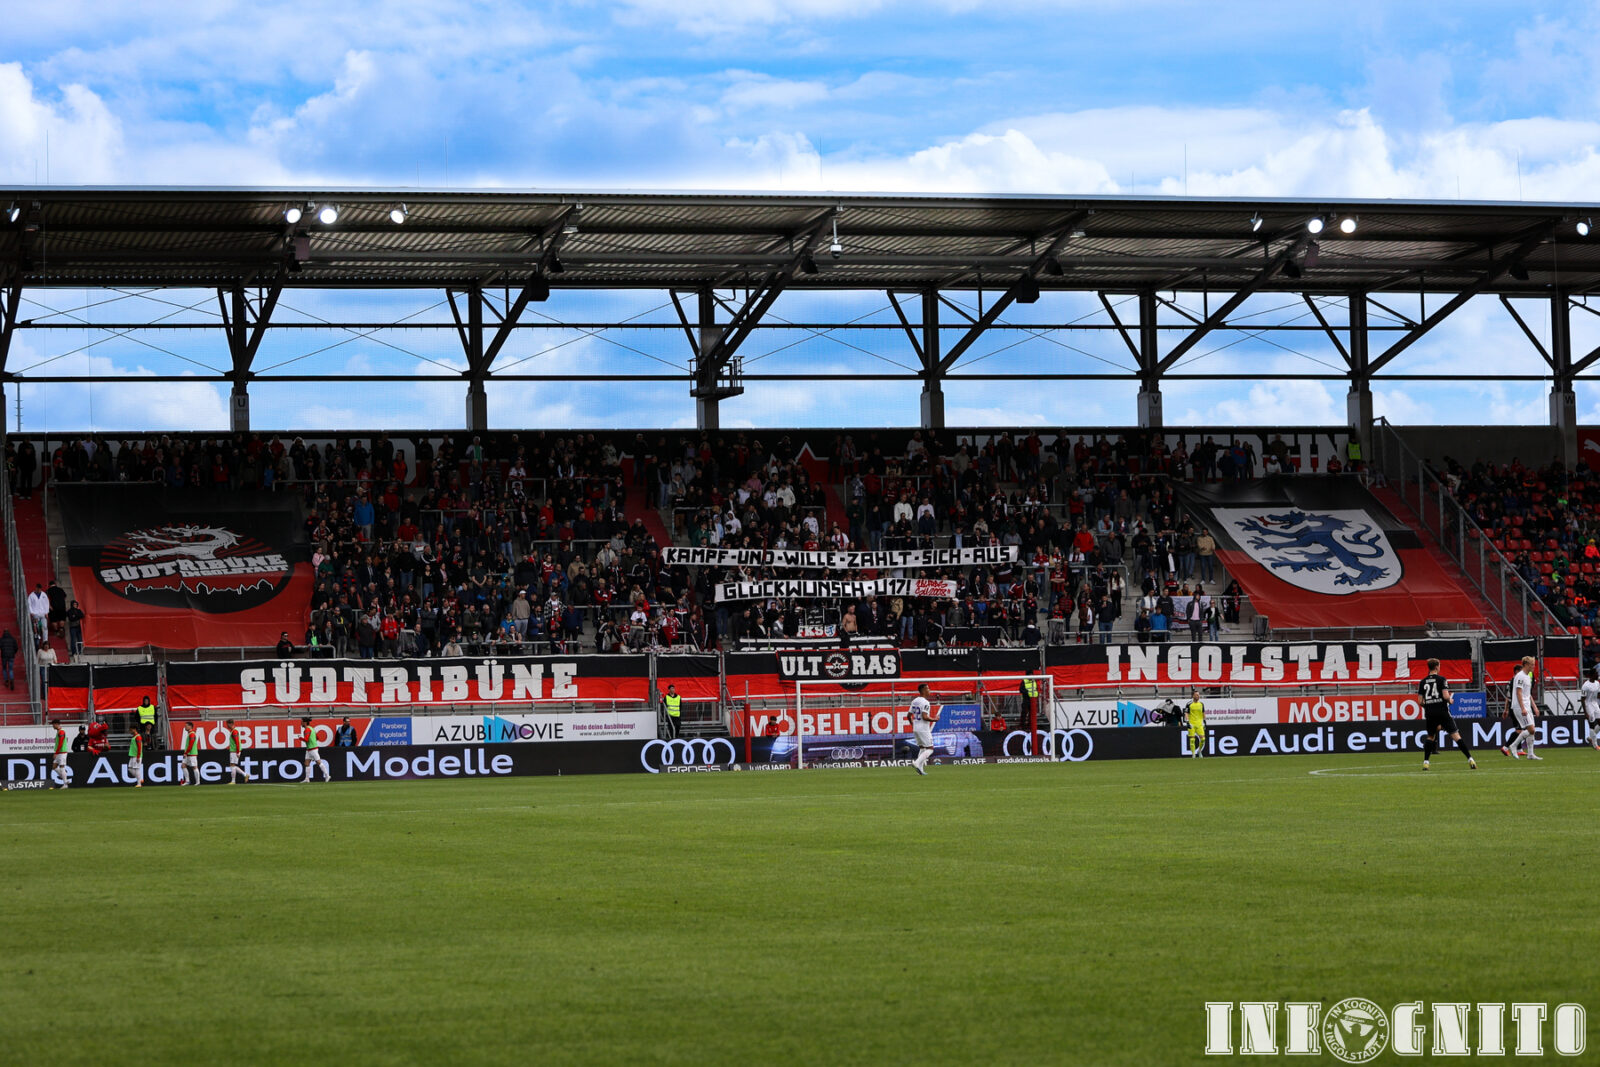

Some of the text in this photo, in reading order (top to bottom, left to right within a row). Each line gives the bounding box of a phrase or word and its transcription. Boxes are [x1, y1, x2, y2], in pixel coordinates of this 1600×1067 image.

[100, 554, 288, 583] SÜDTRIBÜNE
[666, 548, 729, 563] KAMPF
[737, 550, 775, 565] UND
[783, 551, 836, 566] WILLE
[922, 549, 961, 564] SICH
[973, 547, 1009, 563] AUS
[723, 580, 864, 600] GLÜCKWUNSCH
[874, 579, 911, 596] U17!
[1105, 644, 1416, 681] INGOLSTADT
[240, 660, 578, 704] SÜDTRIBÜNE
[1423, 682, 1440, 700] 24
[1072, 710, 1125, 726] AZUBI
[1288, 696, 1426, 723] MÖBELHO
[181, 720, 343, 750] MÖBELHO
[435, 722, 564, 742] AZUBI MOVIE
[1181, 729, 1239, 755] Die
[1250, 726, 1335, 753] Audi
[347, 749, 513, 777] Modelle
[8, 781, 45, 790] guSTAFF
